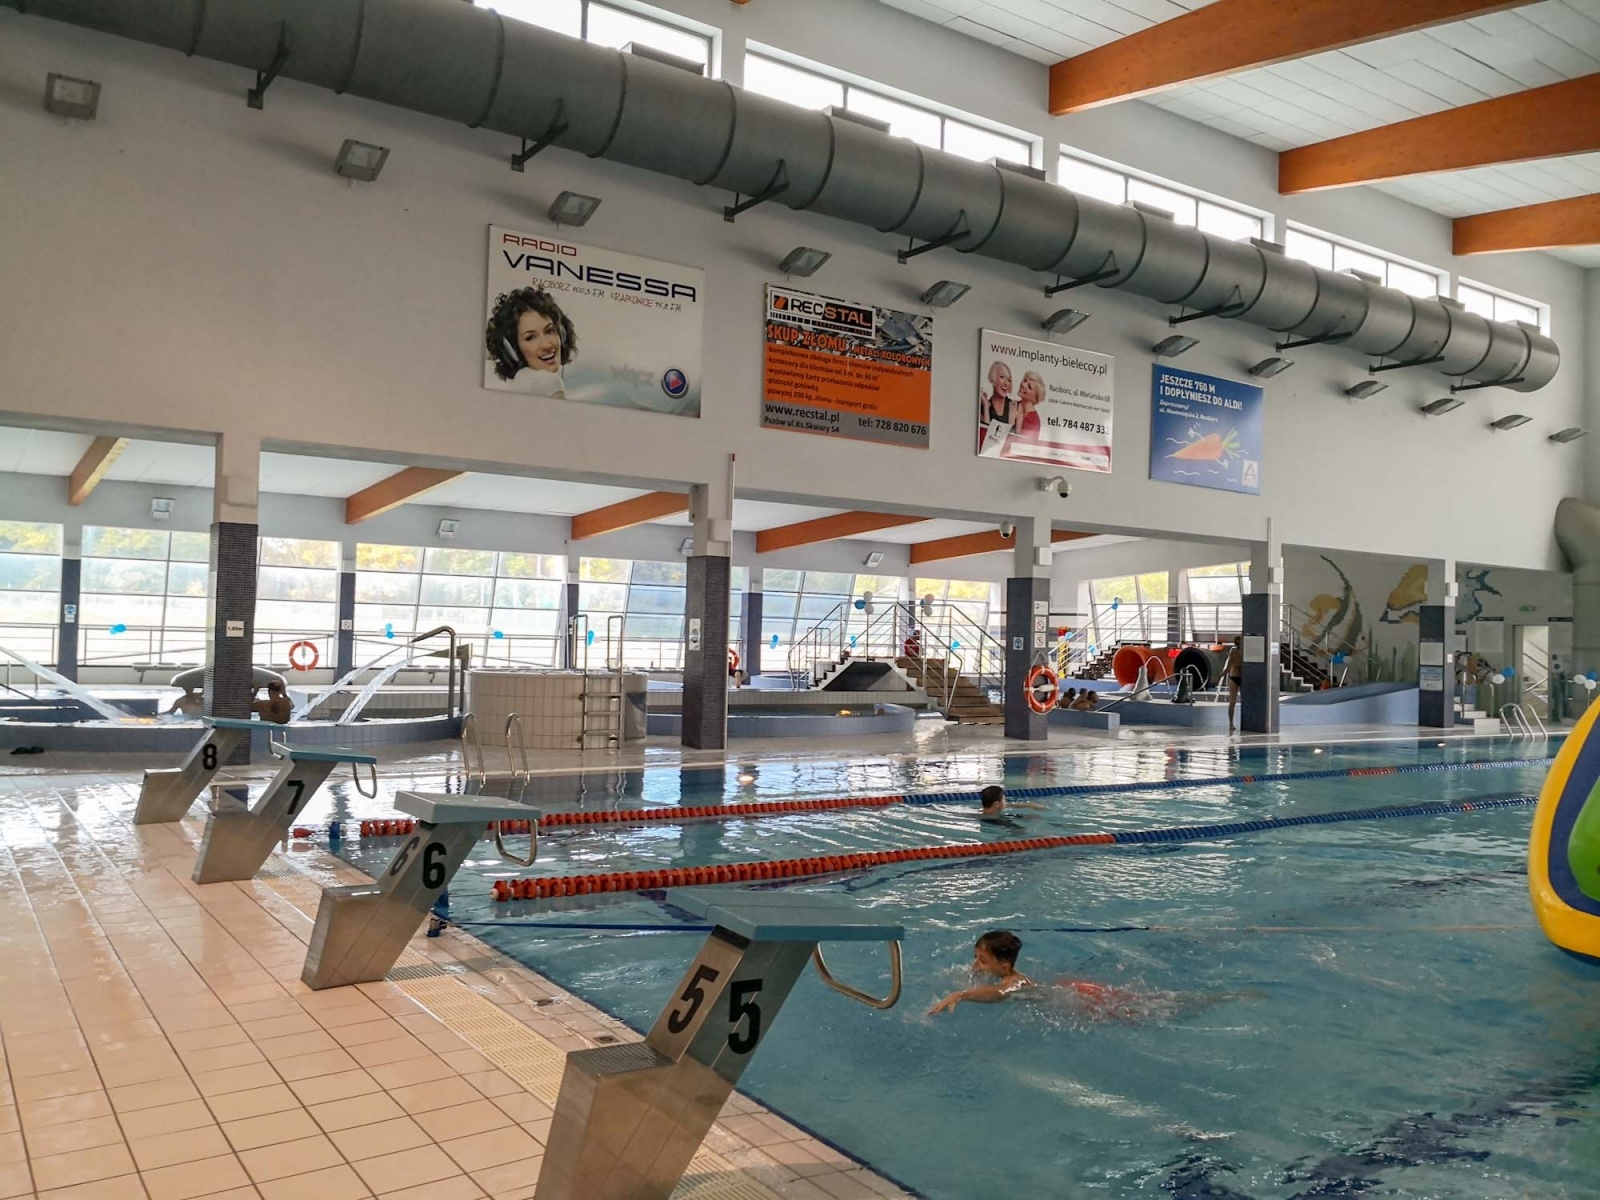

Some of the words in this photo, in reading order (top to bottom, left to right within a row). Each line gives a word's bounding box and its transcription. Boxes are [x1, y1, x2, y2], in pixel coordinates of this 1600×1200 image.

[503, 233, 577, 257] RADIO
[503, 250, 697, 302] VANESSA
[790, 298, 872, 327] RECSTAL
[766, 323, 798, 341] SKUP
[801, 330, 846, 351] ZŁOMU
[881, 350, 931, 367] KOLOROWYCH
[990, 343, 1108, 377] www.implanty-bieleccy.pl
[1160, 373, 1194, 389] JESZCZE
[1194, 381, 1208, 392] 750
[1208, 383, 1216, 394] M
[1164, 386, 1212, 404] DOPŁYNIESZ
[1212, 395, 1223, 406] DO
[764, 416, 786, 427] Pszów
[765, 404, 840, 423] www.recstal.pl
[858, 417, 874, 427] tel:
[875, 419, 892, 430] 728
[893, 421, 909, 433] 820
[911, 424, 927, 436] 676
[1047, 416, 1061, 427] tel.
[1063, 418, 1078, 429] 784
[1079, 421, 1095, 432] 487
[202, 743, 218, 771] 8
[286, 779, 306, 815] 7
[390, 836, 421, 877] 6
[422, 842, 446, 890] 6
[667, 964, 720, 1034] 5
[728, 978, 764, 1055] 5
